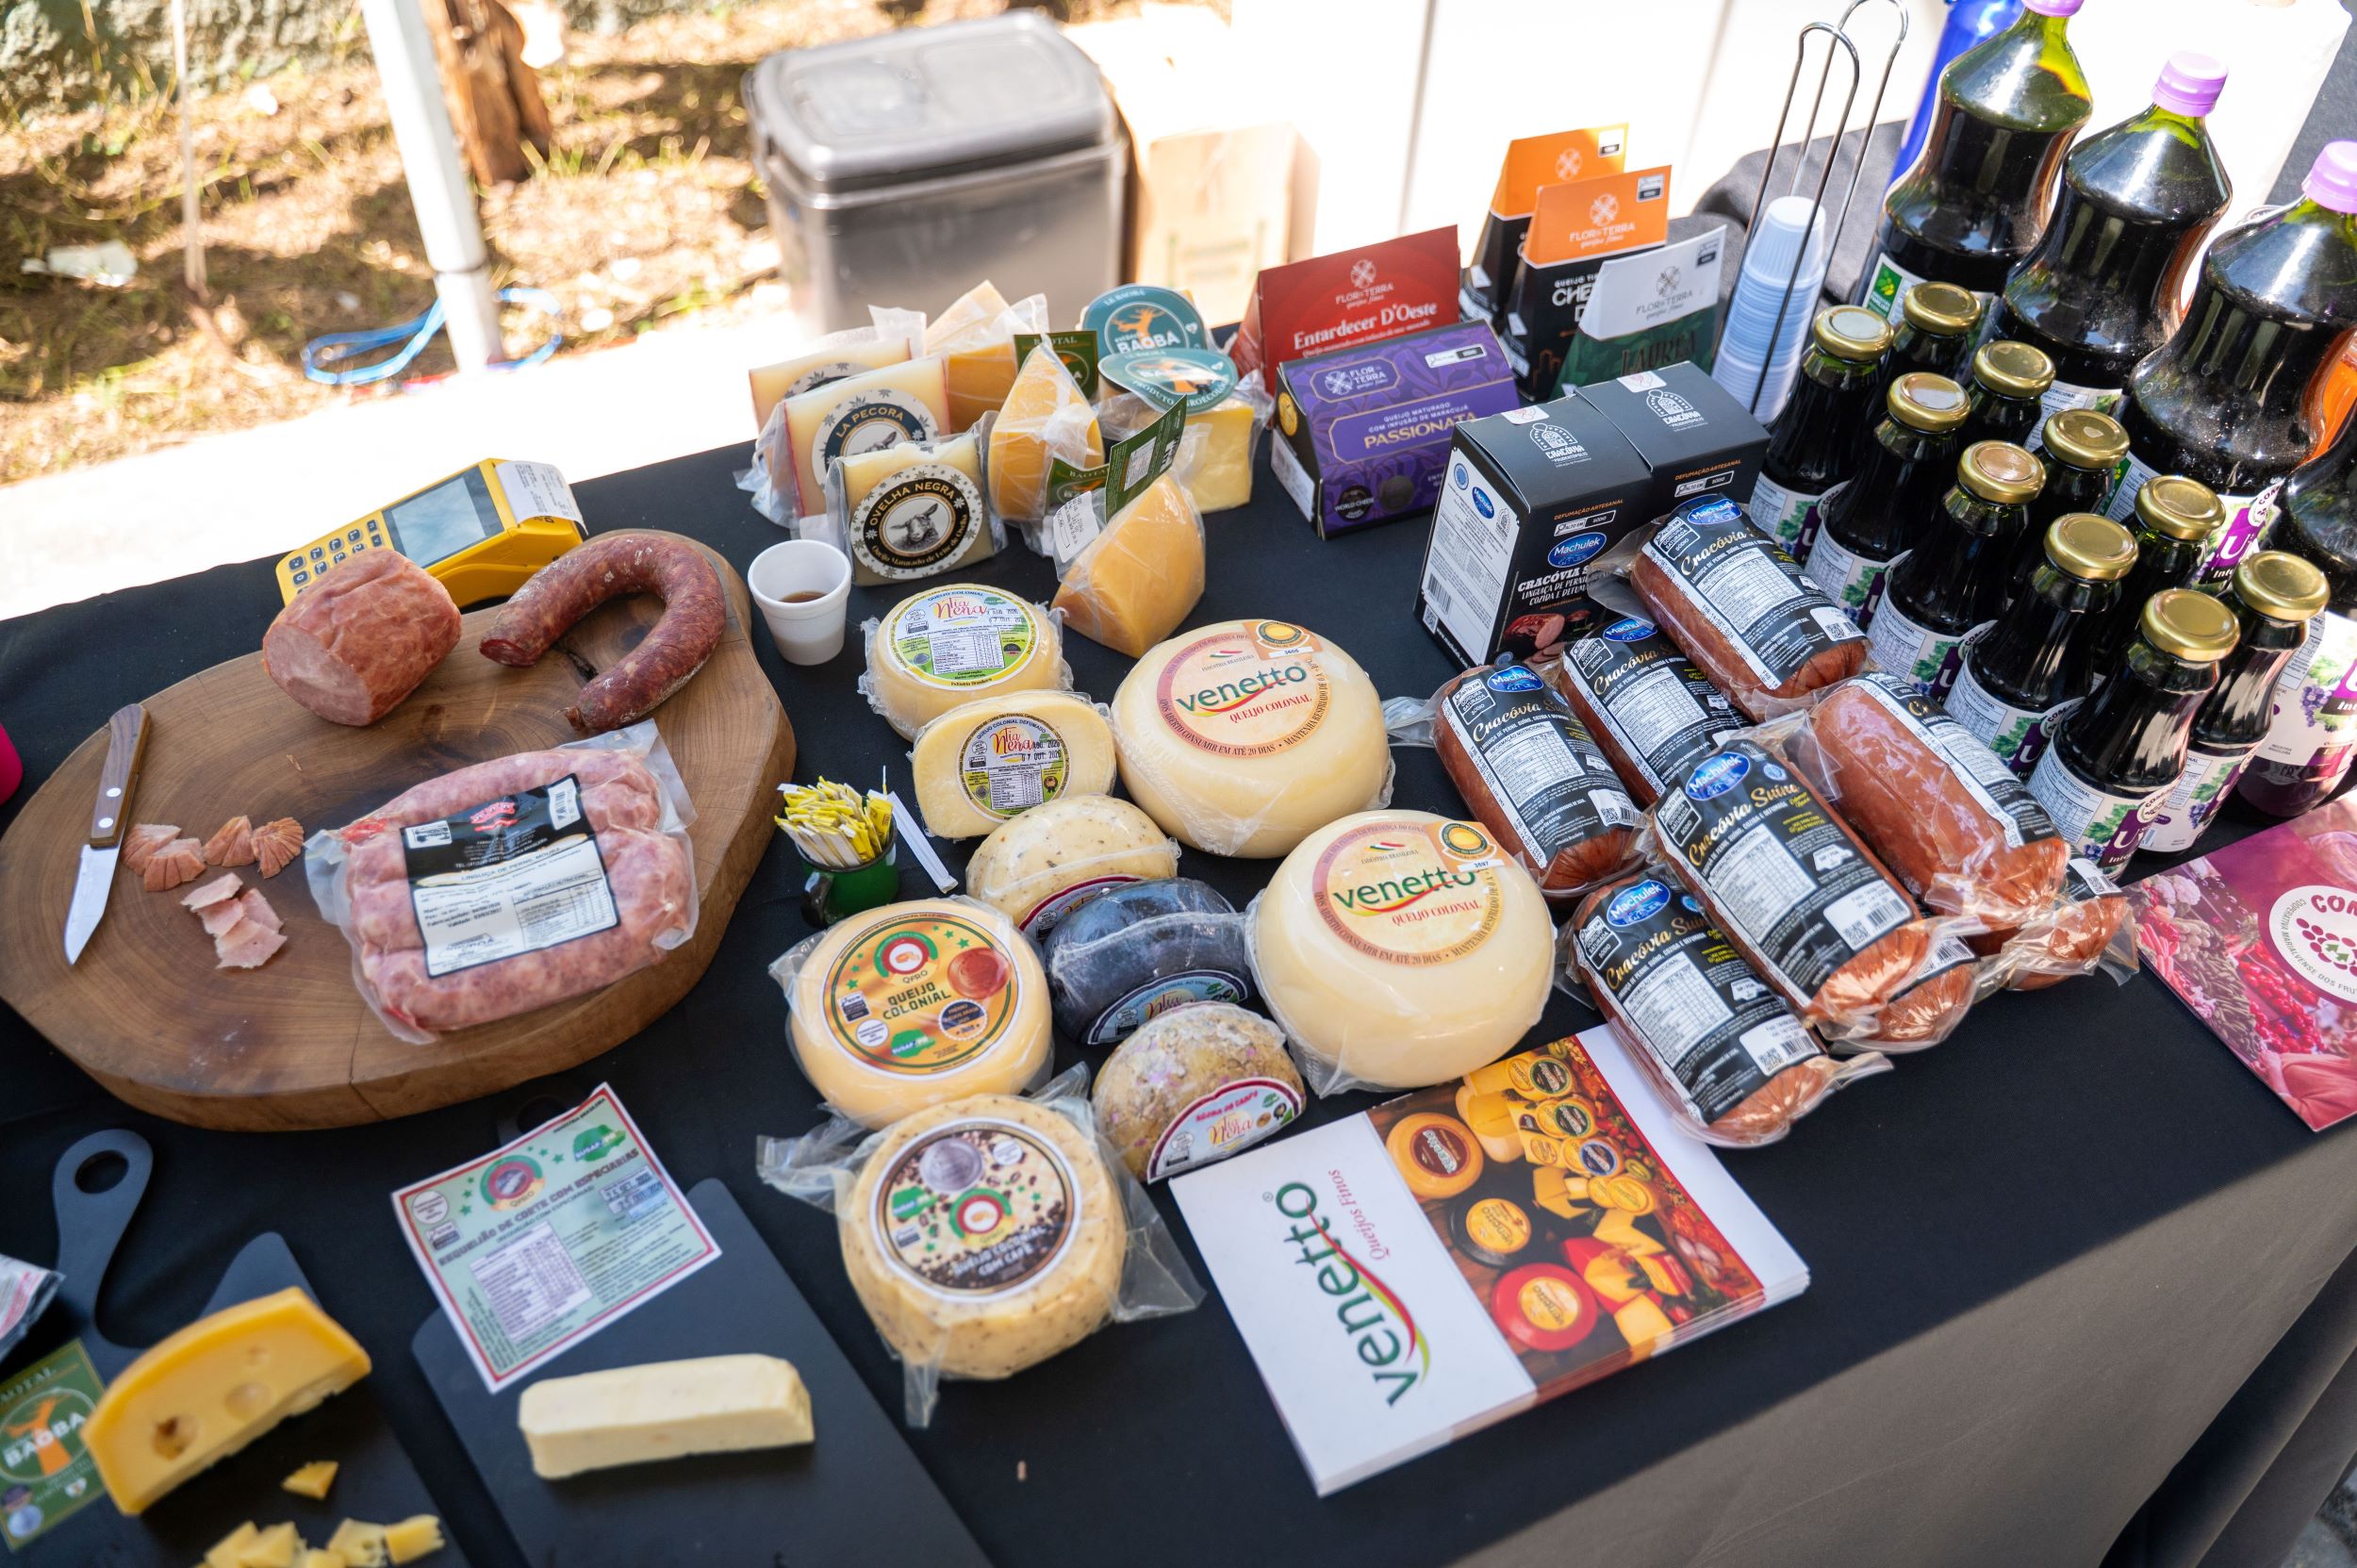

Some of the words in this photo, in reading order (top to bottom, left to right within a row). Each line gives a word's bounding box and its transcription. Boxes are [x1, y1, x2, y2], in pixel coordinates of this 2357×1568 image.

[1569, 228, 1594, 242] FLOR
[1601, 223, 1636, 237] TERRA
[1335, 290, 1359, 305] FLOR
[1364, 283, 1394, 297] TERRA
[1294, 315, 1377, 350] Entardecer
[1380, 303, 1439, 326] D'Oeste
[1349, 366, 1375, 378] FLOR
[1354, 371, 1388, 385] TERRA
[836, 422, 850, 438] LA
[851, 406, 905, 423] PECORA
[1368, 423, 1386, 433] COM
[1387, 415, 1418, 429] INFUSÃO
[1419, 413, 1430, 421] DE
[1430, 403, 1469, 419] MARACUJÁ
[1383, 410, 1410, 422] QUEIJO
[1411, 402, 1451, 417] MATURADO
[1363, 411, 1476, 450] PASSIONATA
[1545, 444, 1586, 460] CRACÓVIA
[1674, 468, 1710, 481] DEFUMAÇÃO
[1709, 459, 1741, 471] ARTESANAL
[869, 487, 911, 526] OVELHA
[915, 481, 955, 500] NEGRA
[1554, 506, 1590, 520] DEFUMAÇÃO
[1590, 499, 1624, 512] ARTESANAL
[1554, 536, 1601, 557] Machulek
[1681, 530, 1747, 575] Cracóvia
[1517, 566, 1581, 592] CRACÓVIA
[1702, 562, 1728, 585] INFORMAÇÃO
[1522, 585, 1553, 601] LINGUIÇA
[1554, 582, 1563, 591] DE
[1529, 592, 1555, 606] COZIDA
[1556, 590, 1561, 599] E
[929, 599, 987, 619] Nena
[1593, 650, 1659, 696] Cracóvia
[1612, 685, 1638, 705] INFORMAÇÃO
[1637, 669, 1665, 685] NUTRICIONAL
[1176, 665, 1307, 713] venetto
[1229, 707, 1264, 724] QUEIJO
[1266, 693, 1313, 714] COLONIAL
[1473, 702, 1542, 742] Cracóvia
[977, 726, 993, 739] QUEIJO
[992, 718, 1019, 729] COLONIAL
[1018, 718, 1047, 734] DEFUMADO
[990, 733, 1032, 754] Nena
[999, 726, 1022, 740] Tia
[1164, 711, 1184, 734] ABERTO
[1181, 729, 1218, 752] CONSUMIR
[1217, 745, 1231, 755] EM
[1231, 745, 1247, 756] ATÉ
[1248, 747, 1258, 756] 20
[1258, 744, 1277, 755] DIAS
[1283, 718, 1318, 747] MANTENHA
[1490, 734, 1517, 753] INFORMAÇÃO
[1516, 723, 1546, 736] NUTRICIONAL
[1689, 754, 1743, 792] Machulek
[2063, 773, 2091, 799] NUTRICIONAL
[1689, 801, 1752, 867] Cracóvia
[1332, 866, 1476, 910] venetto
[1609, 883, 1663, 918] Machulek
[1392, 909, 1431, 928] QUEIJO
[1431, 900, 1483, 917] COLONIAL
[2281, 898, 2307, 930] COOPERATIVA
[1339, 927, 1377, 957] CONSUMIR
[1378, 949, 1393, 962] EM
[1422, 952, 1442, 965] DIAS
[1451, 927, 1488, 957] MANTENHA
[1607, 929, 1672, 990] Cracóvia
[2281, 930, 2317, 975] MARIALVENSE
[882, 989, 951, 1019] COLONIAL
[887, 981, 936, 1006] QUEIJO
[498, 1219, 514, 1232] DE
[514, 1198, 550, 1226] CORTE
[549, 1184, 573, 1203] COM
[574, 1147, 640, 1189] ESPECIARIAS
[1327, 1168, 1357, 1209] Finos
[1349, 1206, 1392, 1262] Queijos
[1276, 1180, 1418, 1408] venetto
